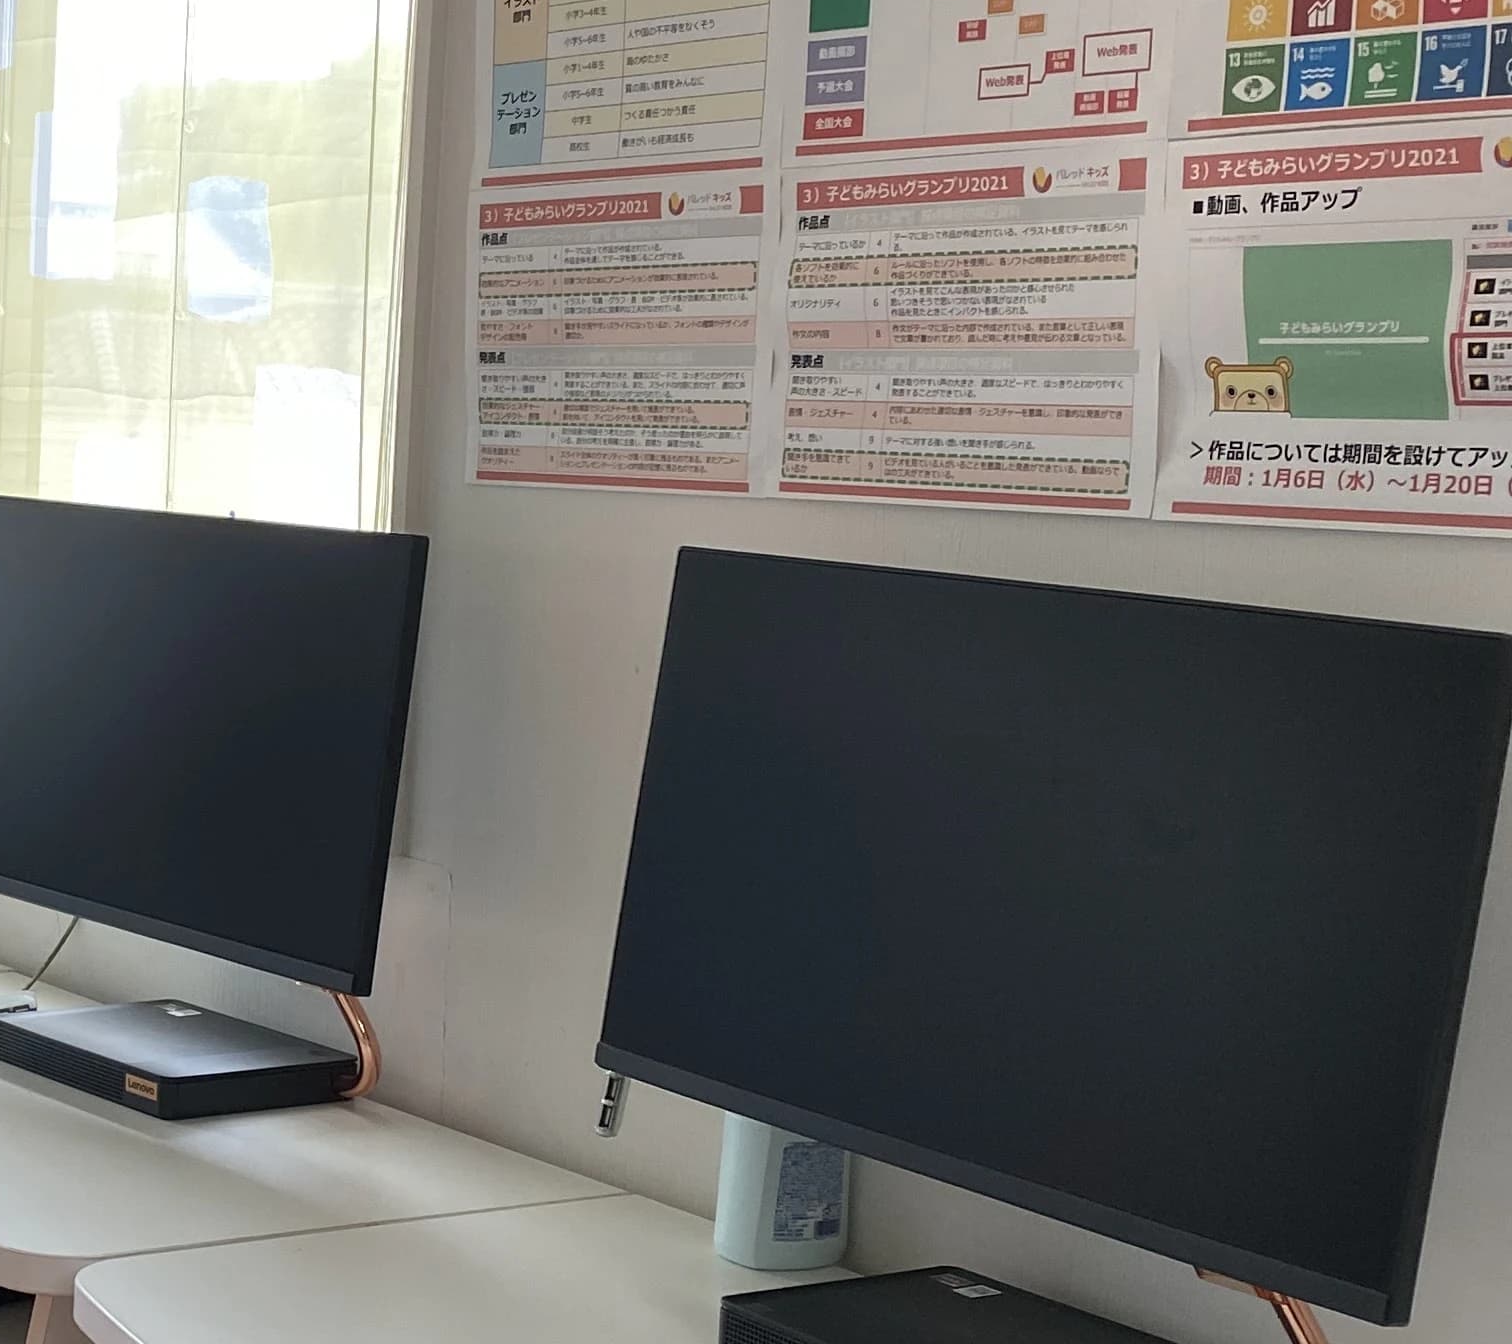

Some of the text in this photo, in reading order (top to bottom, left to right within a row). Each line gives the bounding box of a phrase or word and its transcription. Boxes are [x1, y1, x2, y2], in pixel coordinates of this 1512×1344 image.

[1425, 35, 1438, 50] 16
[1495, 29, 1507, 44] 17
[1293, 48, 1304, 62] 14
[1358, 41, 1369, 56] 15
[1230, 52, 1240, 67] 13
[501, 91, 537, 105] プレゼン
[497, 107, 541, 120] テーション
[1206, 186, 1362, 216] 動画、作品アップ
